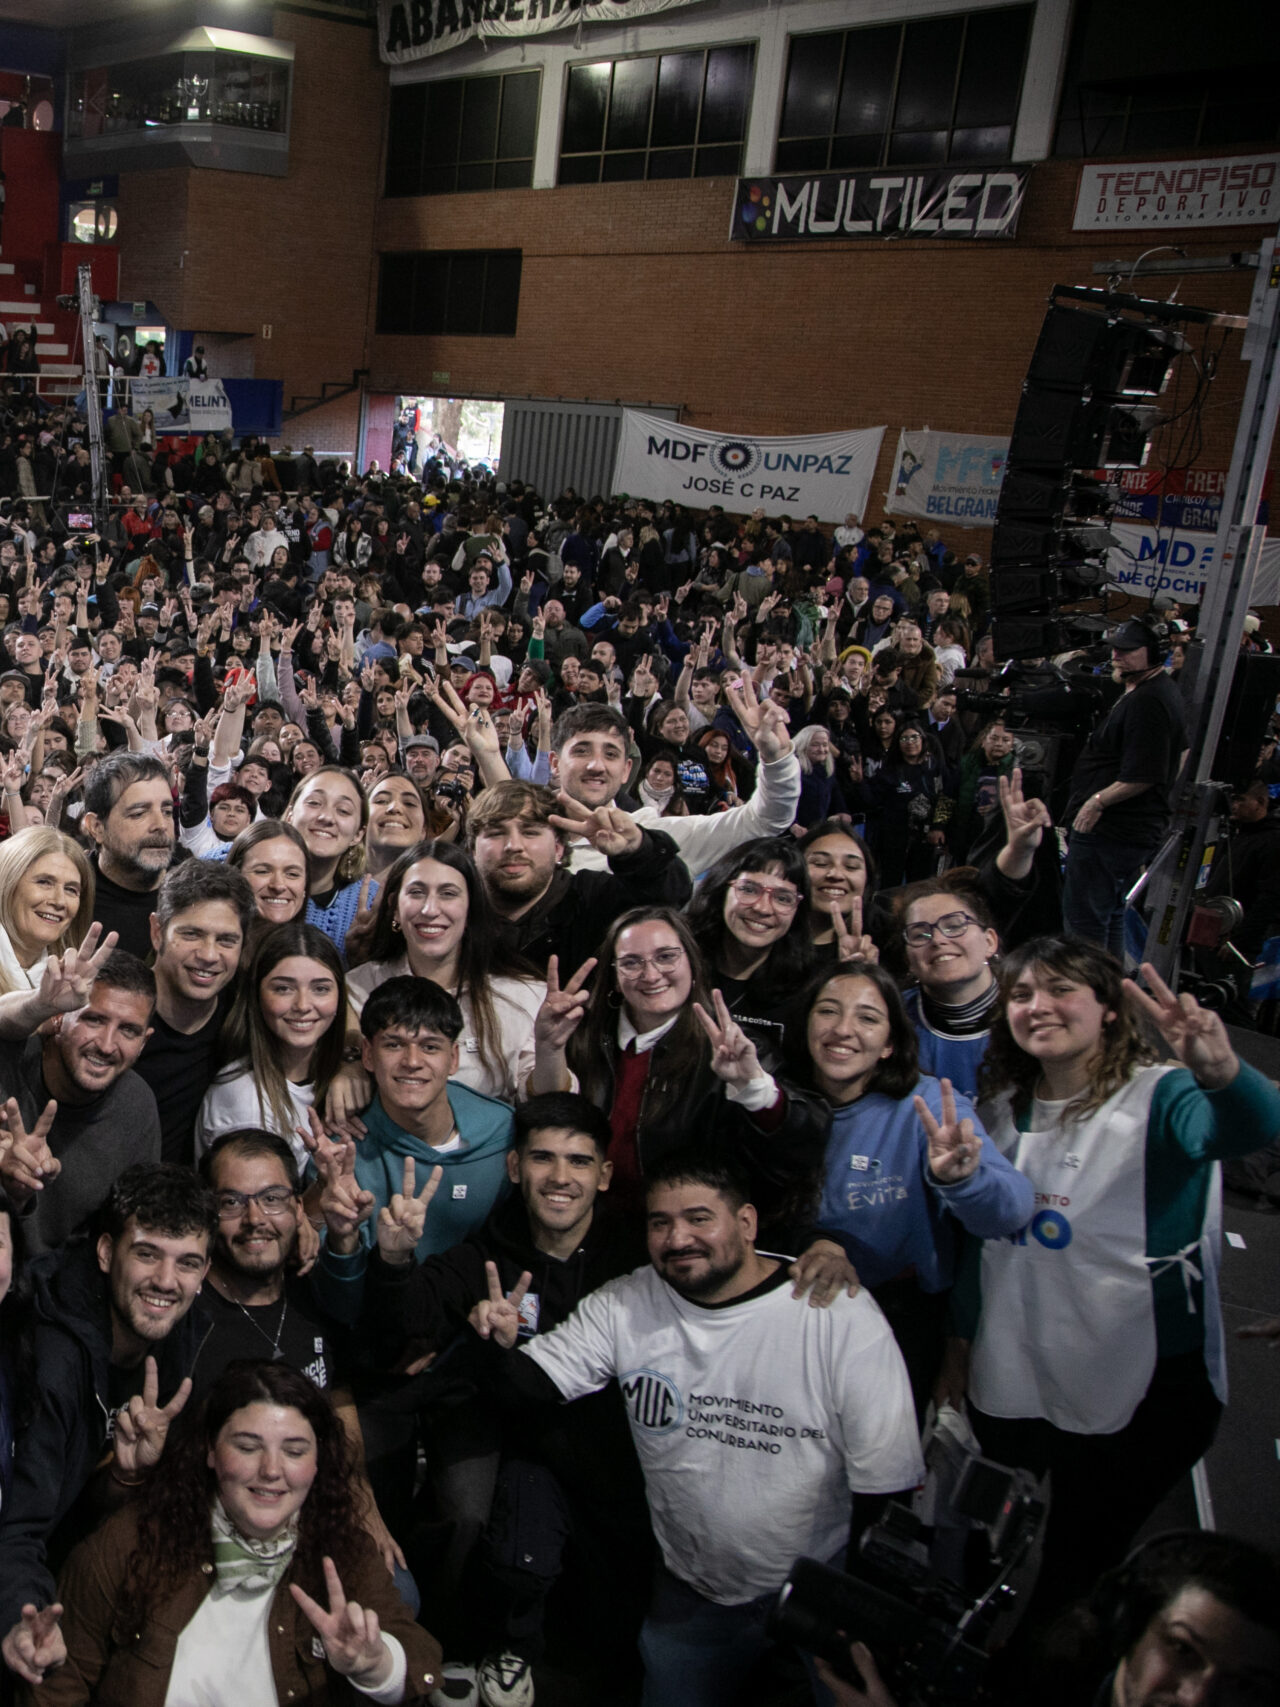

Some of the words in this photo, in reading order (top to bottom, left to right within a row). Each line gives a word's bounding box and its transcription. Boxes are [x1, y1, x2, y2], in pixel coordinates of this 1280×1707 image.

[1096, 162, 1276, 197] TECNOPISO
[772, 173, 1022, 234] MULTILED
[1097, 190, 1271, 214] DEPORTIVO
[647, 436, 708, 463] MDF
[763, 453, 853, 475] UNPAZ
[683, 475, 735, 495] JOSÉ
[741, 483, 754, 497] C
[760, 484, 801, 502] PAZ
[847, 1186, 909, 1211] Evita
[689, 1393, 785, 1419] MOVIMIENTO
[687, 1409, 797, 1439] UNIVERSITARIO
[800, 1429, 827, 1440] DEL
[686, 1426, 782, 1455] CONURBANO
